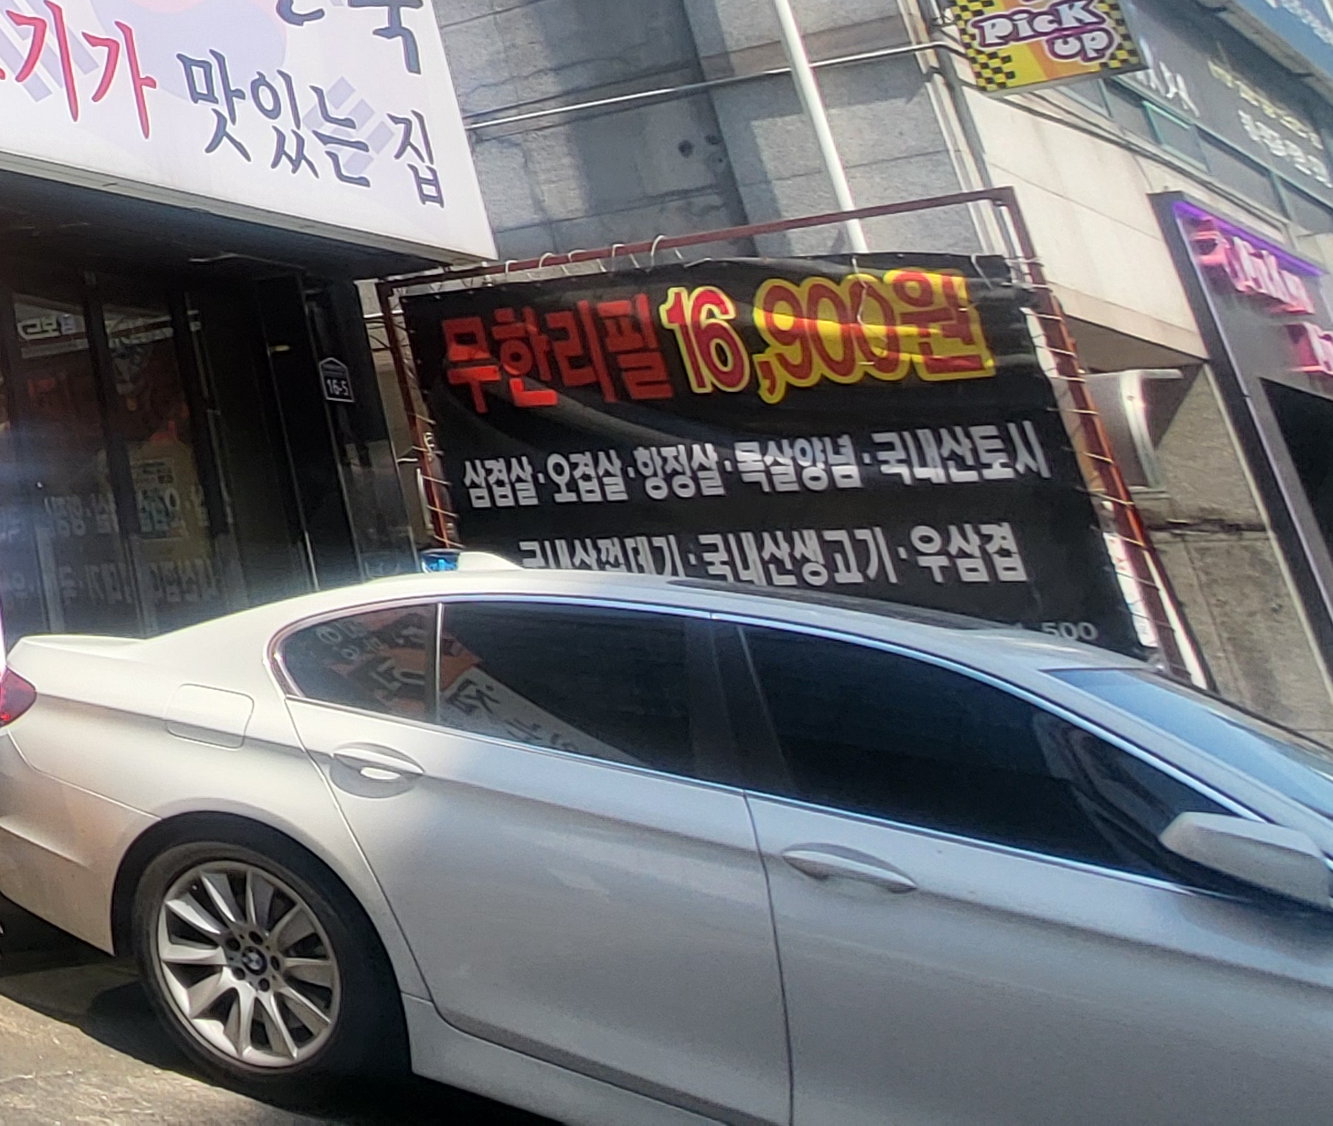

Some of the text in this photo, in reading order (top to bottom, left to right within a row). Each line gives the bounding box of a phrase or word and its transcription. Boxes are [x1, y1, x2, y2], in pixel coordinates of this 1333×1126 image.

[176, 48, 371, 188] 맛있는
[386, 109, 445, 209] 집
[440, 268, 997, 415] 무한리필 16,900원
